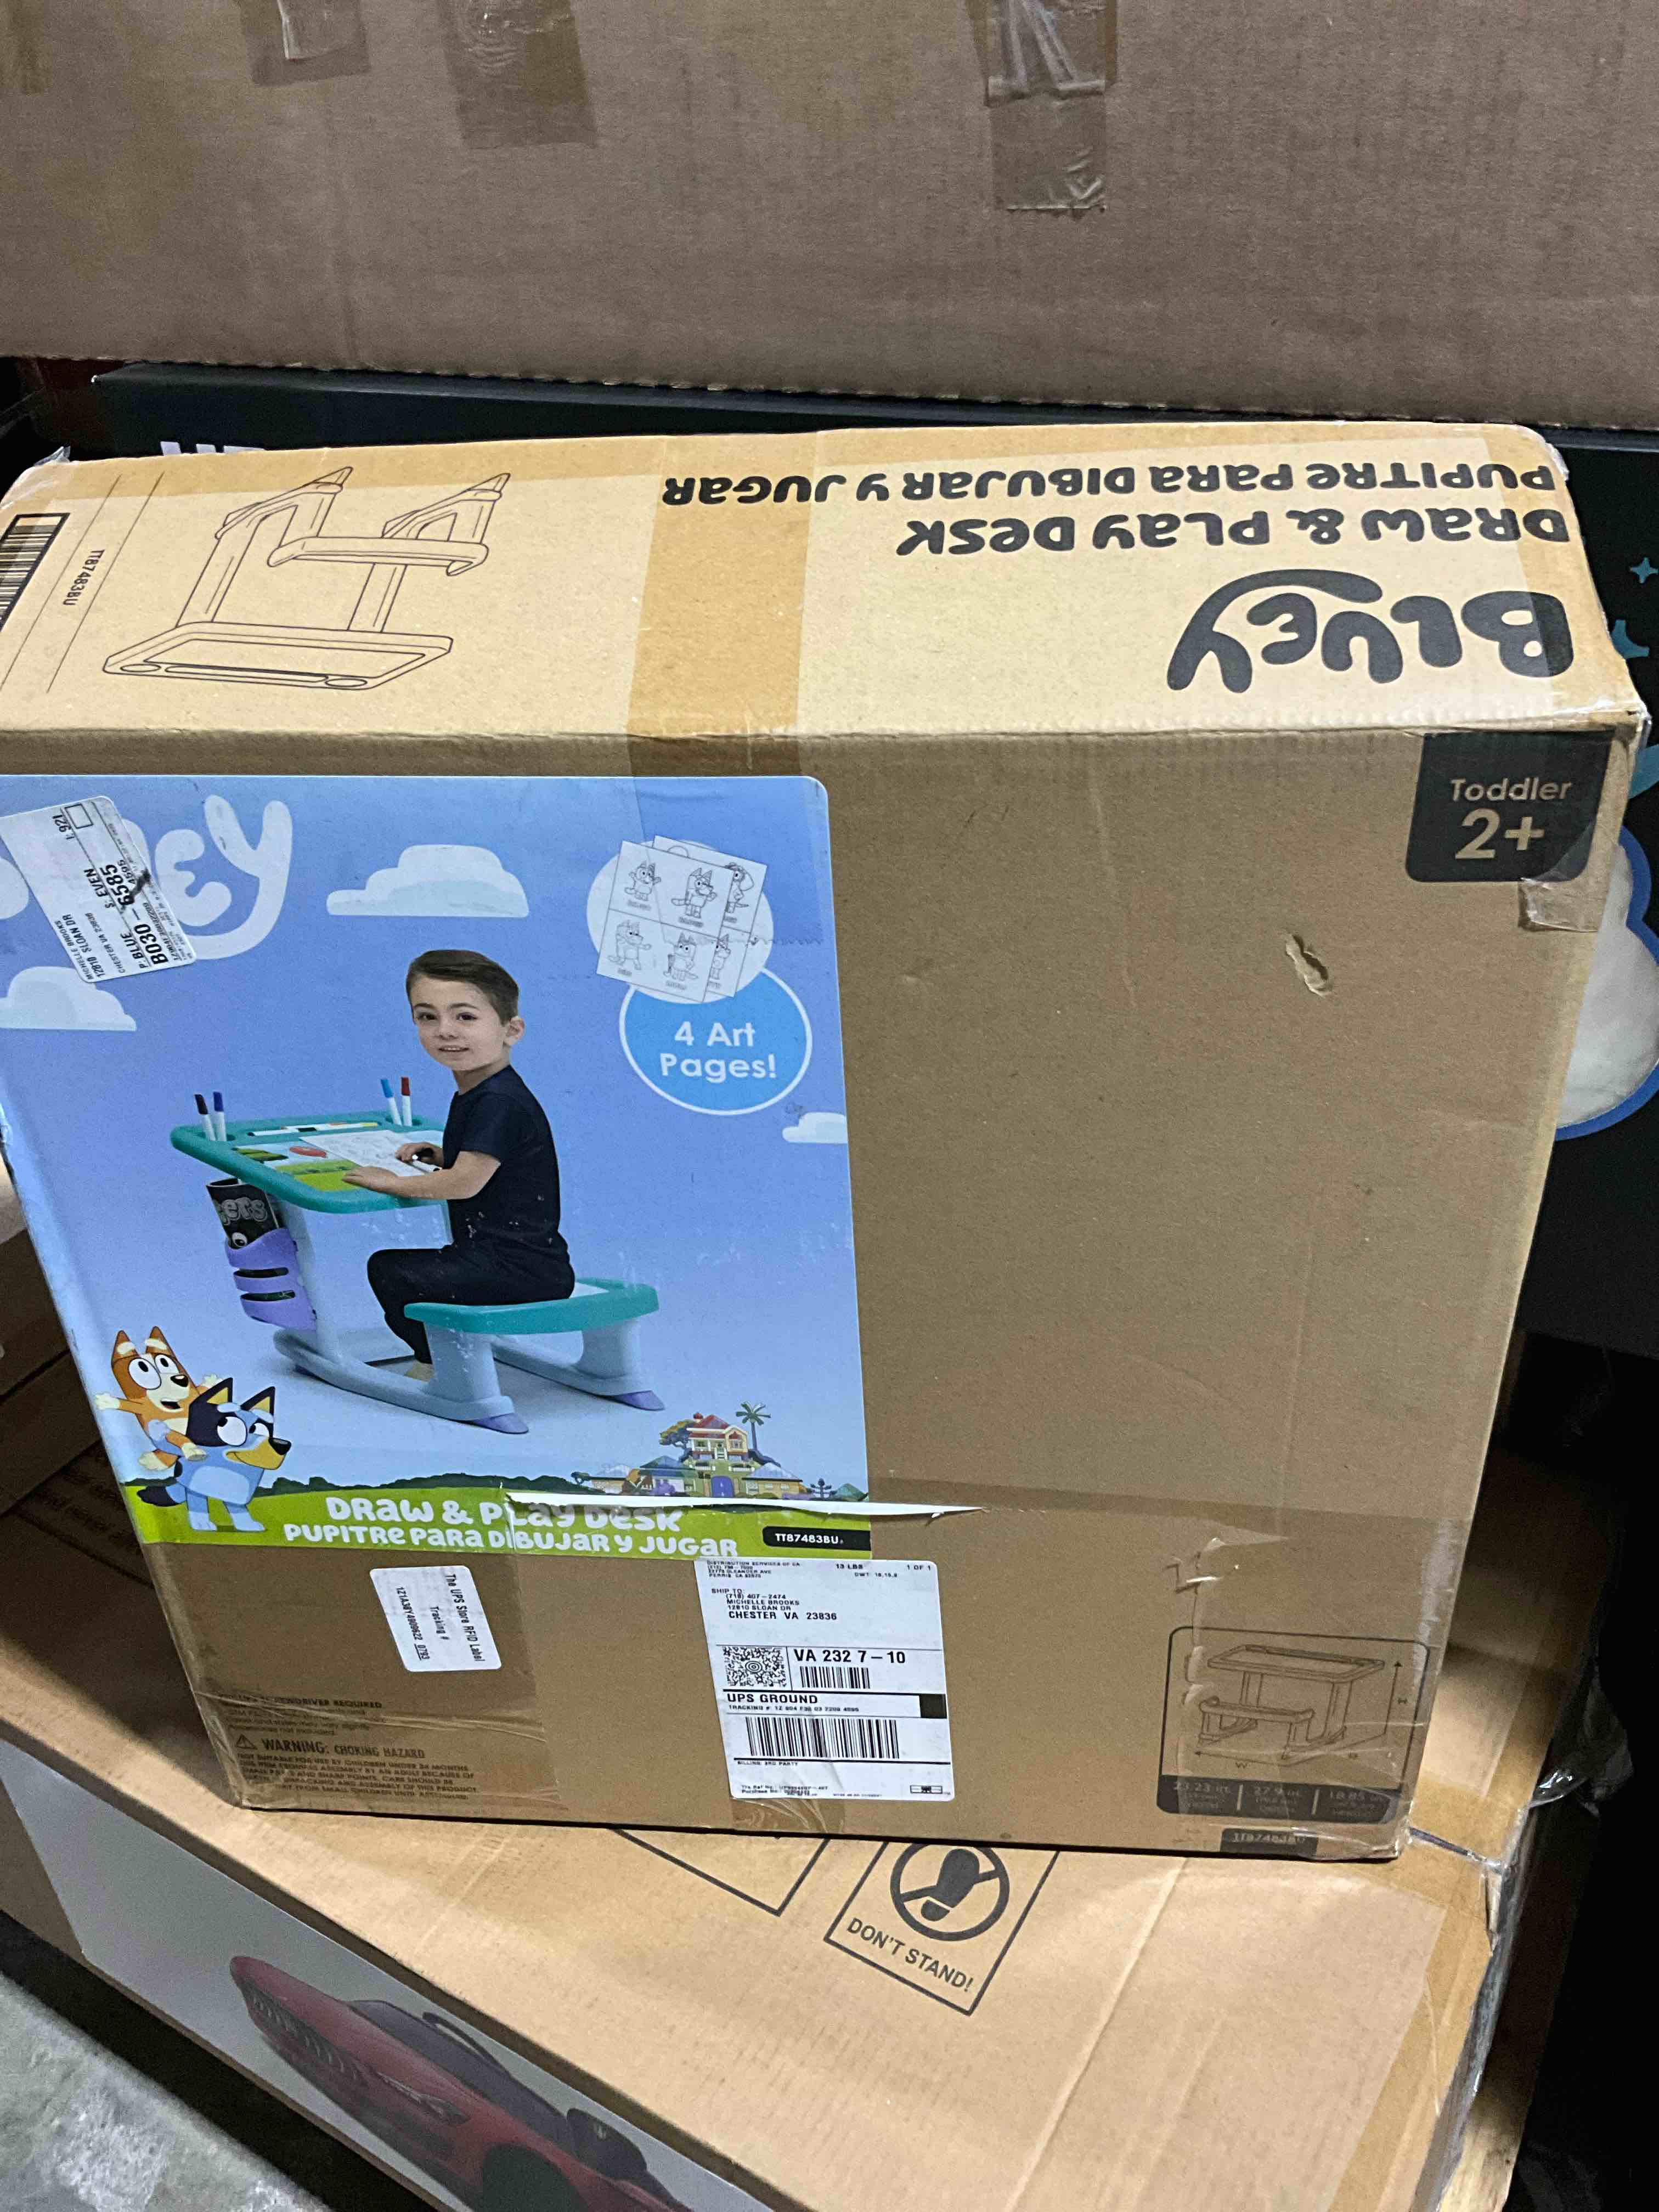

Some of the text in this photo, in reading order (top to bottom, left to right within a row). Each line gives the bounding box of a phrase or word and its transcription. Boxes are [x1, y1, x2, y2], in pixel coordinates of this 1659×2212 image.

[1286, 508, 1345, 545] &
[63, 550, 105, 606] TT87483BU
[1166, 568, 1574, 694] BLUEY
[1449, 776, 1573, 803] Toddler
[1454, 809, 1545, 860] 2+
[83, 868, 109, 898] EVEN
[61, 913, 76, 926] DR
[54, 919, 94, 980] MICHELLE BROOKS
[70, 928, 89, 953] SLOAN
[97, 934, 109, 943] VA
[120, 932, 144, 959] BLUE
[103, 944, 126, 974] CHESTER
[674, 1021, 756, 1047] 4 Art
[660, 1053, 777, 1083] Pages!
[442, 1501, 473, 1525] &
[430, 1607, 446, 1634] Tracking
[445, 1574, 486, 1661] The UPS Store RFID Label
[729, 1611, 776, 1619] CHESTER
[806, 1612, 837, 1620] 23836
[793, 1649, 816, 1662] VA
[822, 1650, 852, 1663] 232
[727, 1693, 818, 1703] UPS GROUND
[262, 1738, 425, 1759] WARNING: CHOKING HAZARD
[847, 1918, 974, 1992] DON'T STAND!
